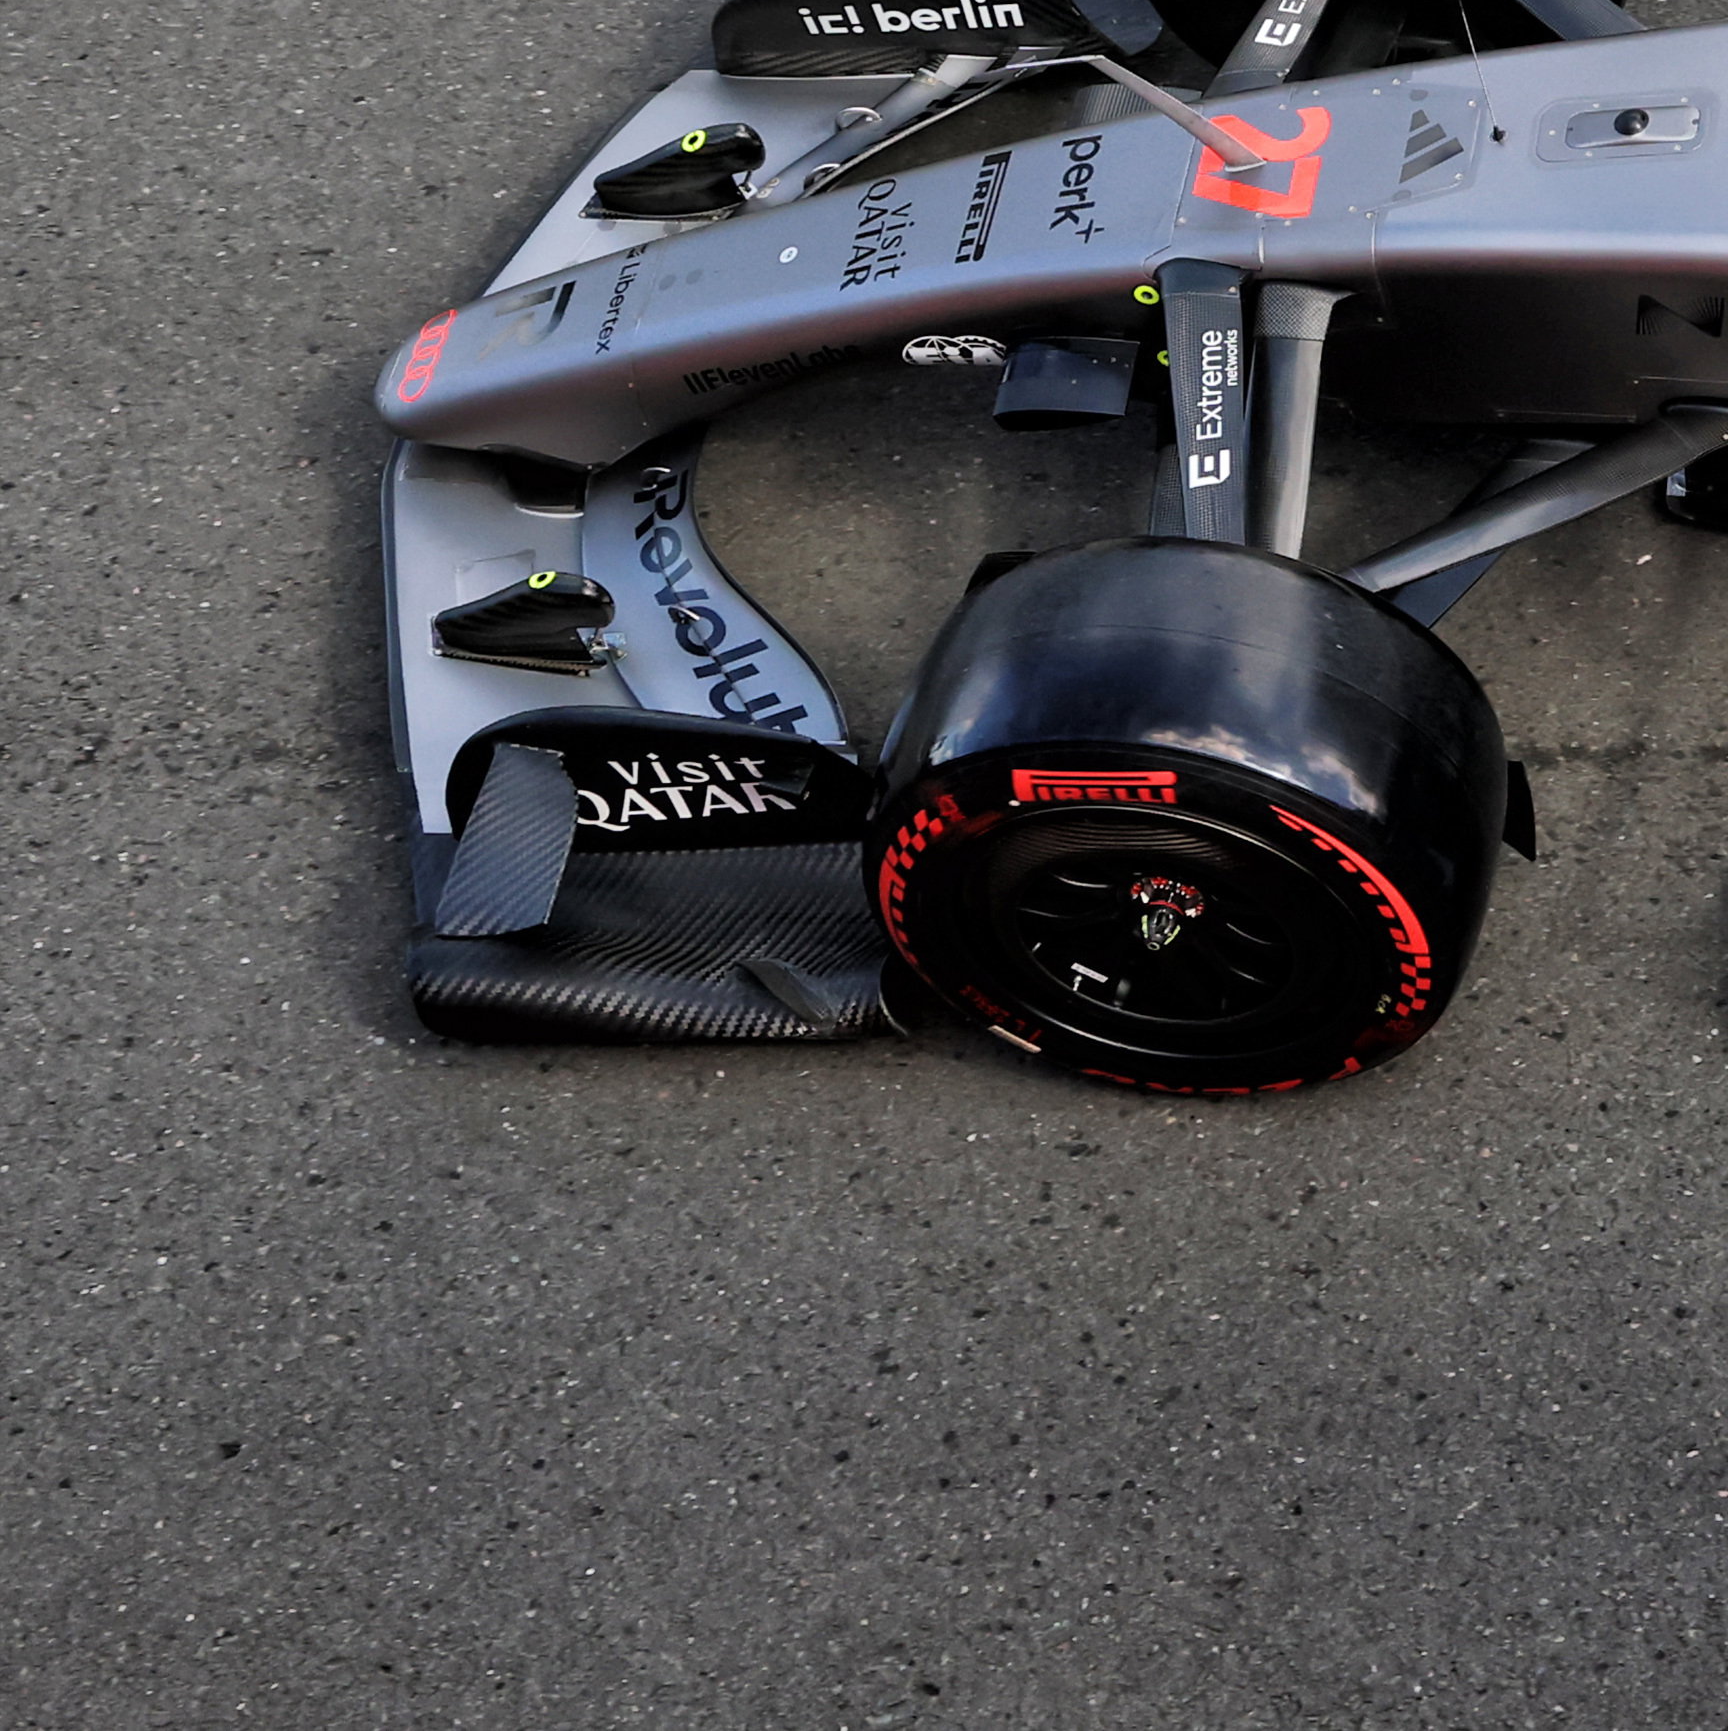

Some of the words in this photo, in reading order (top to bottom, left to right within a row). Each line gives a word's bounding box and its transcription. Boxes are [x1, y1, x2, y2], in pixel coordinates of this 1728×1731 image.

[799, 2, 866, 37] ic!
[955, 150, 1012, 264] PIRELLI
[1192, 106, 1332, 219] 27
[840, 178, 896, 291] QATAR
[874, 202, 915, 282] visit
[595, 259, 641, 355] Libertex
[1195, 329, 1223, 441] Extreme
[1227, 328, 1239, 388] networks
[632, 469, 809, 735] Revolut
[607, 752, 766, 786] visit
[1012, 768, 1177, 805] PIRELLI
